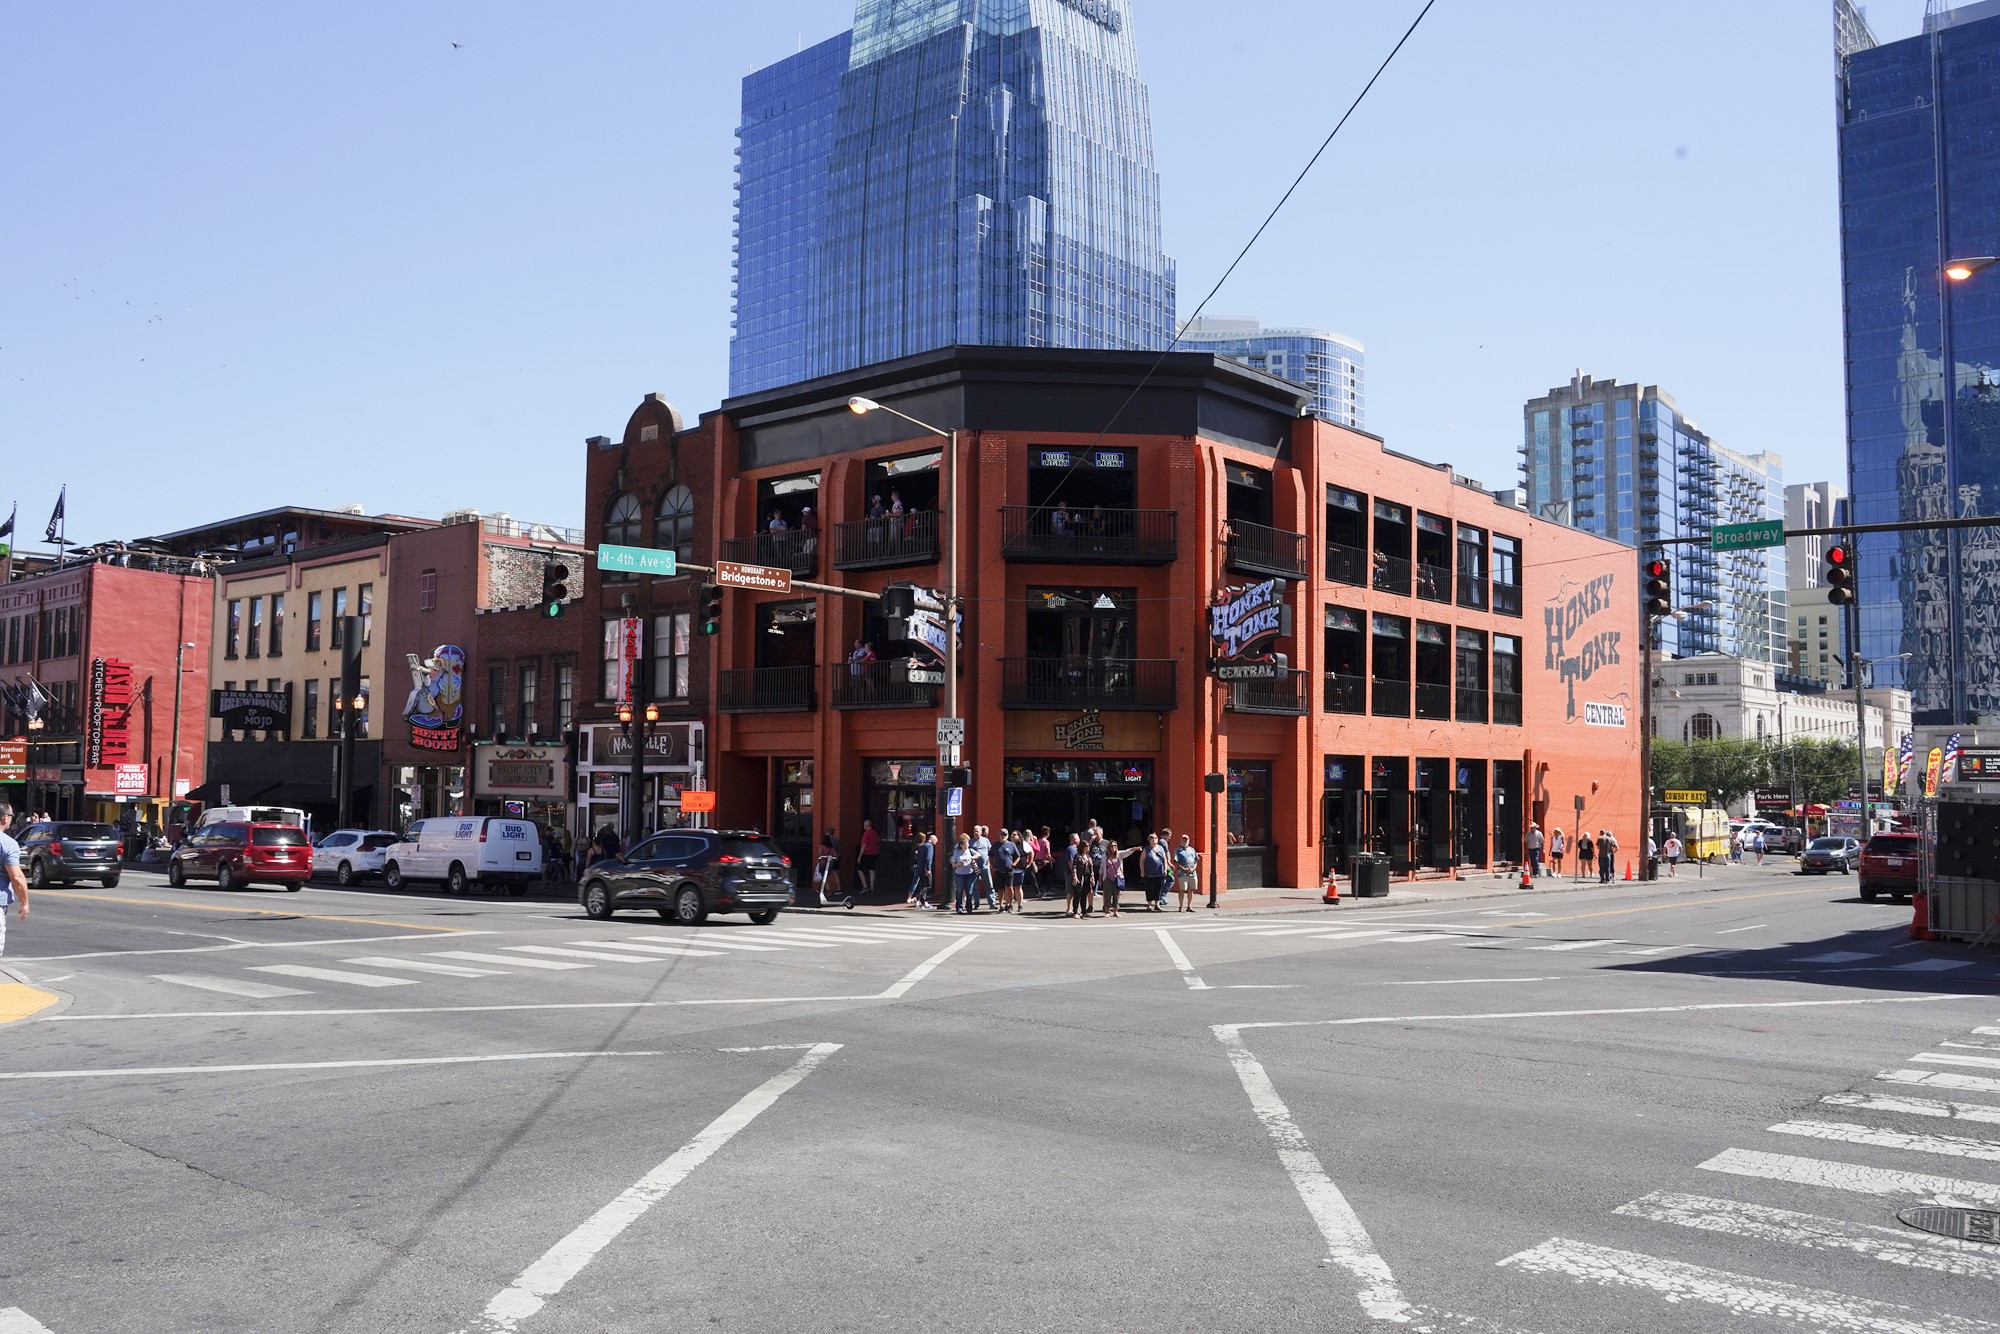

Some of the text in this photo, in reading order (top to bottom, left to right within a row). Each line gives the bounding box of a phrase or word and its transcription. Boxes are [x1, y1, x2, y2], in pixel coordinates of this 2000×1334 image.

[1715, 529, 1779, 545] Broadway
[741, 565, 765, 576] HONORARY
[721, 570, 787, 588] Bridgestone Dr
[1212, 579, 1275, 636] HONKY
[1544, 573, 1614, 670] HONKY
[1223, 607, 1280, 657] TONK
[1218, 664, 1275, 679] CENTRAL
[1559, 631, 1620, 721] TONK
[220, 691, 288, 699] BROADWAY
[101, 657, 134, 765] JASON ALDEAN
[219, 697, 287, 714] BREWHOUSE
[1585, 703, 1625, 726] CENTRAL
[244, 716, 273, 729] MOJO
[1055, 713, 1099, 740] HONKY
[412, 725, 460, 740] BETTY
[938, 731, 949, 742] OK
[1065, 725, 1103, 749] TONK
[412, 735, 458, 751] BOOTS
[1077, 742, 1104, 750] CENTRAL
[117, 772, 145, 780] PARK
[497, 764, 544, 775] MUSIC CITY
[117, 780, 145, 788] HERE
[1665, 792, 1707, 801] COWBOY HATS
[459, 822, 473, 831] BUD
[505, 825, 522, 833] BUD
[454, 830, 474, 839] LIGHT
[502, 831, 526, 839] LIGHT
